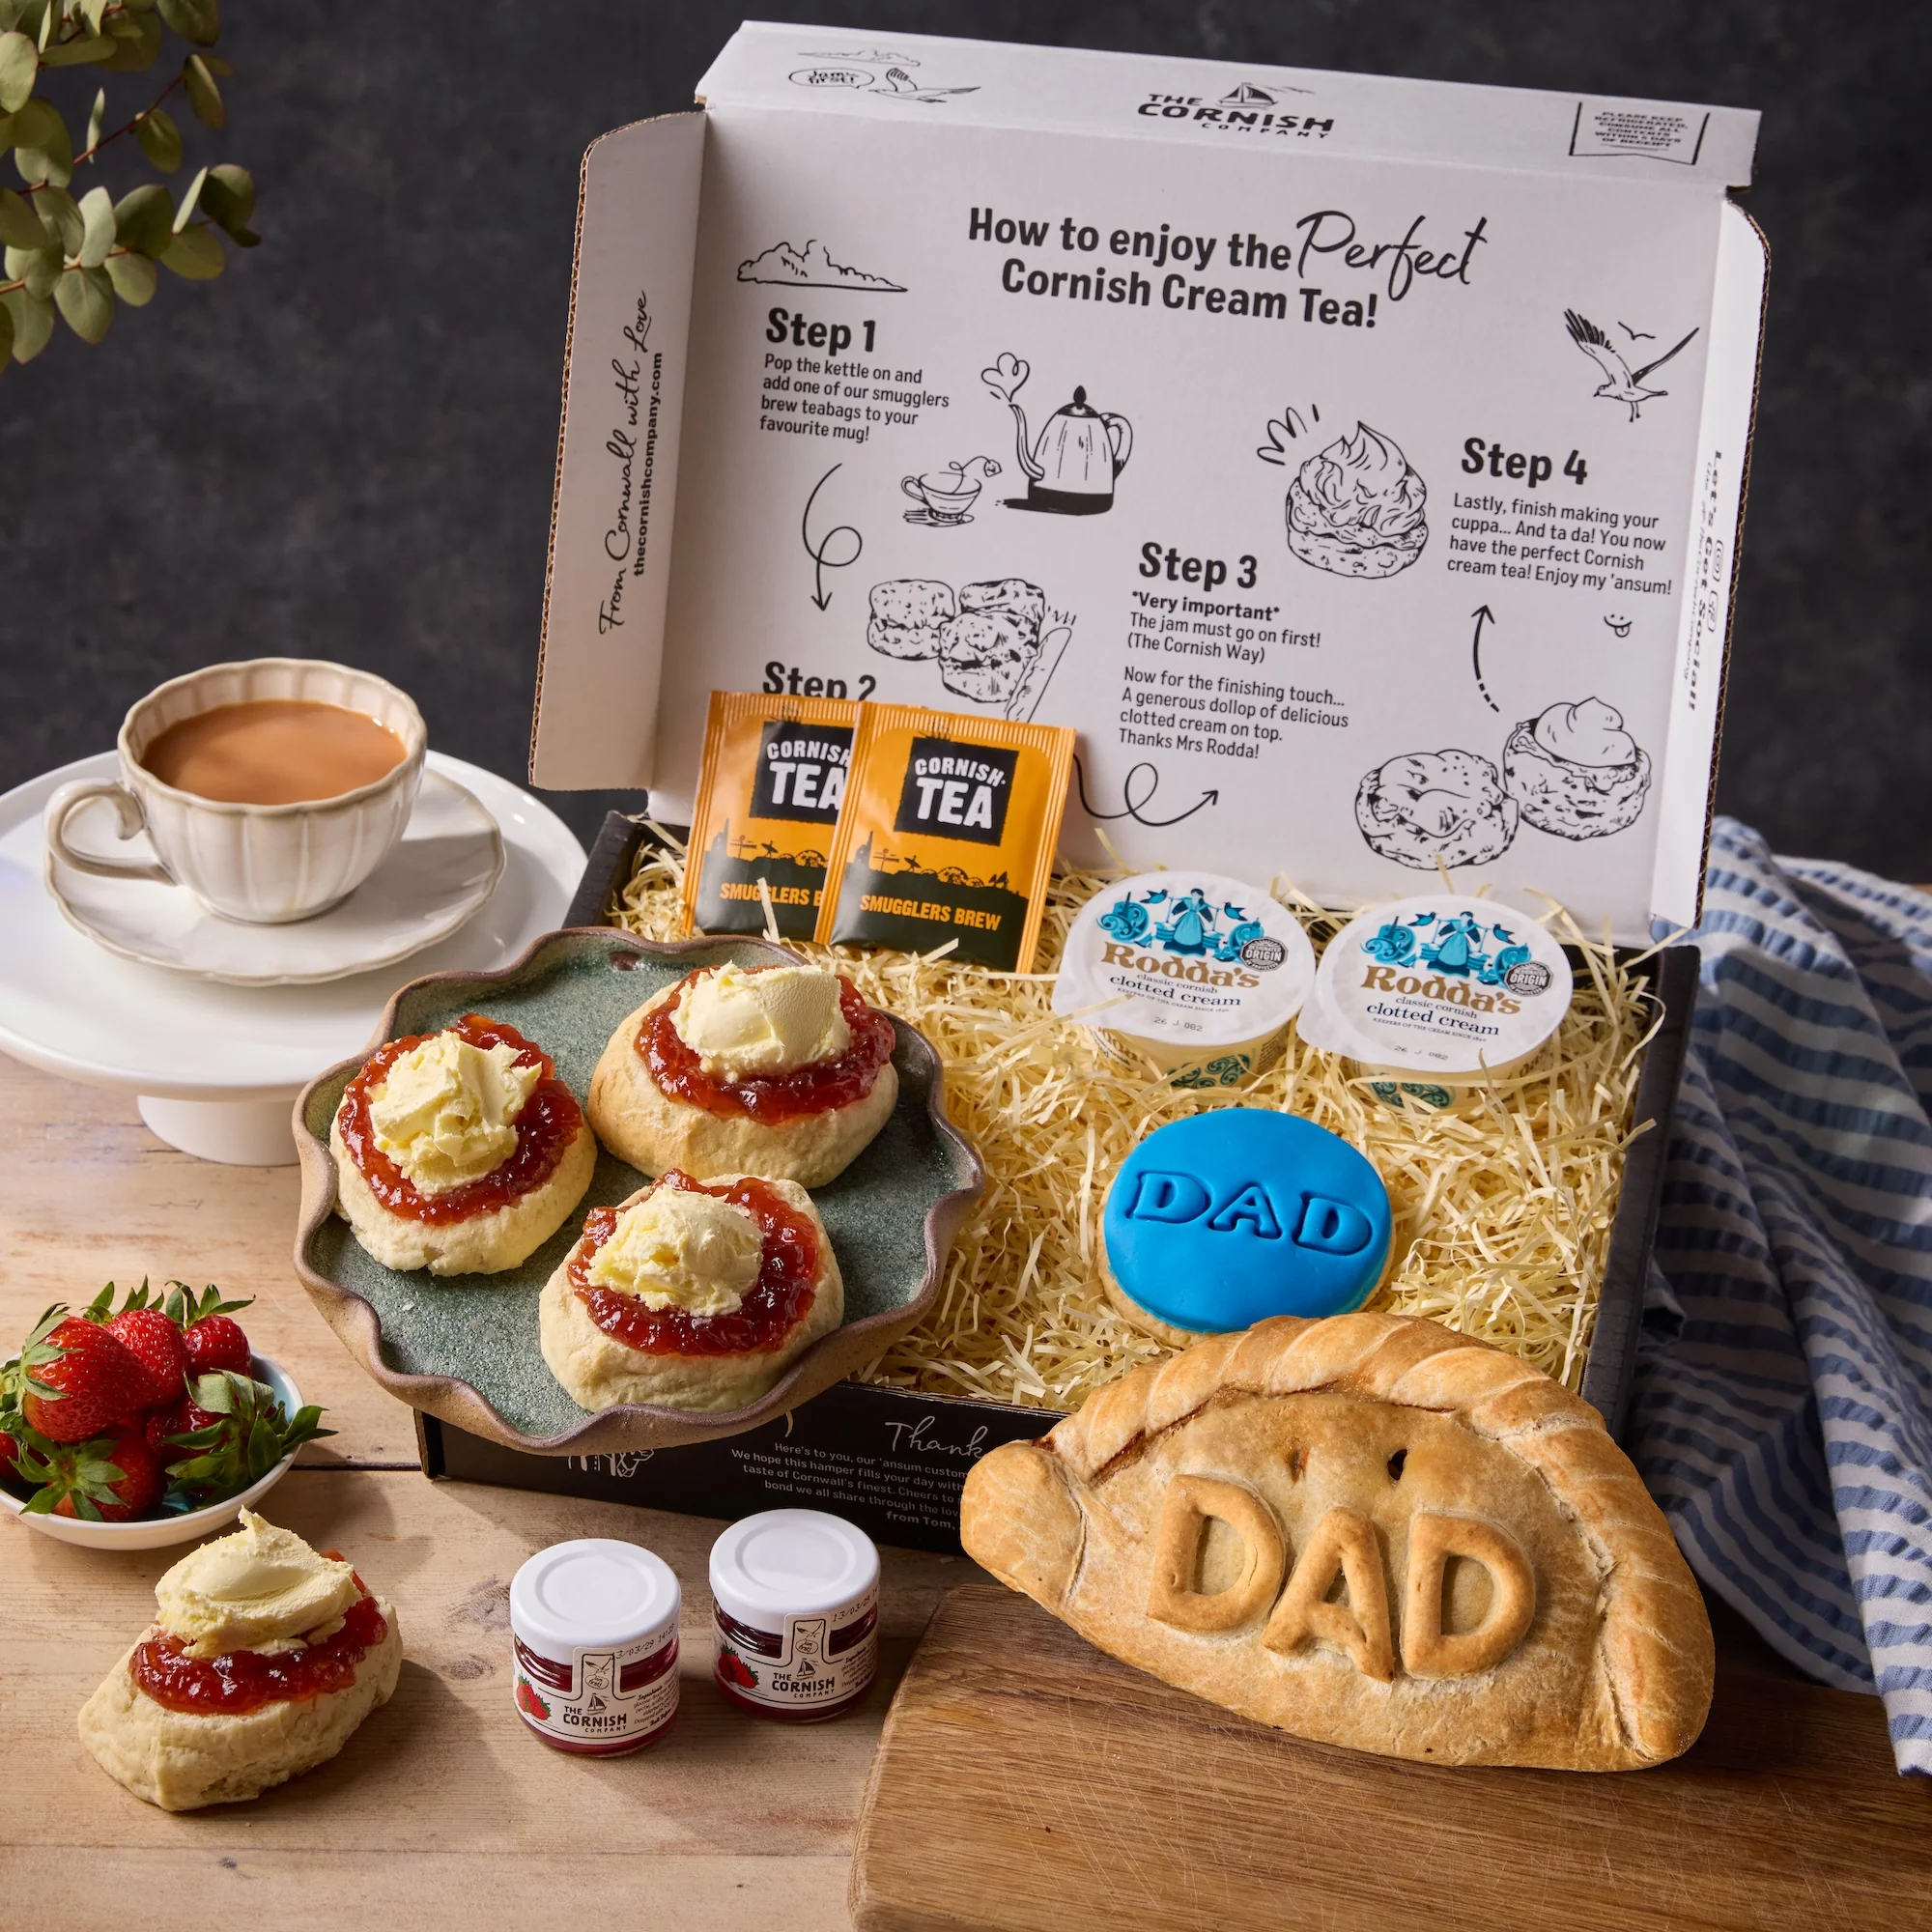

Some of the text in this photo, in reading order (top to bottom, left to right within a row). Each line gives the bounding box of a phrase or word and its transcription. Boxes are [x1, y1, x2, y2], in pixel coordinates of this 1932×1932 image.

[1137, 103, 1335, 132] CORNISH
[1148, 94, 1204, 106] THE
[1201, 123, 1329, 139] COMPANY
[968, 207, 1489, 301] How to enjoy the Perfect
[1001, 258, 1379, 329] Cornish Cream Tea!
[765, 306, 877, 357] Step 1
[764, 353, 923, 384] Pop the kettle on and
[760, 394, 920, 427] brew teabags to your
[762, 375, 951, 409] add one of our smugglers
[759, 414, 870, 445] favourite mug!
[598, 289, 653, 636] From Cornwall with Love
[633, 352, 663, 578] thecornishcompany.com
[1461, 436, 1589, 490] Step 4
[1453, 492, 1661, 530] Lastly, finish making your
[1449, 534, 1645, 572] have the perfect Cornish
[1451, 516, 1667, 553] cuppa... And ta da! You now
[1138, 540, 1259, 593] Step 3
[1446, 558, 1673, 596] cream tea! Enjoy my 'ansum!
[1699, 535, 1714, 591] Get
[1129, 611, 1322, 649] The jam must go on first!
[1126, 631, 1266, 667] (The Cornish Way)
[762, 660, 848, 700] Step
[1123, 666, 1347, 708] Now for the finishing touch...
[1121, 687, 1350, 728] A generous dollop of delicious
[1119, 727, 1261, 760] Thanks Mrs Rodda!
[1120, 709, 1284, 745] clotted cream on top.
[766, 740, 852, 768] CORNISH
[914, 756, 1003, 787] CORNISH
[769, 760, 846, 810] TEA
[915, 777, 993, 830] TEA
[859, 894, 952, 923] SMUGGLERS
[953, 909, 1002, 931] BREW
[1100, 941, 1262, 989] Rodda's
[1245, 949, 1283, 962] ORIGIN
[1109, 976, 1241, 1007] clotted cream
[1136, 973, 1218, 995] classic cornish
[1359, 964, 1522, 1016] Rodda's
[1509, 973, 1548, 987] ORIGIN
[1153, 1016, 1168, 1026] 26
[1184, 1022, 1204, 1033] 082
[1366, 1002, 1500, 1036] clotted cream
[1395, 996, 1478, 1019] classic cornish
[1393, 1045, 1408, 1054] 26
[1126, 1169, 1374, 1257] DAD
[885, 1415, 989, 1460] Thank
[731, 1448, 965, 1492] We hope this hamper fills your day with
[774, 1441, 968, 1480] Here's to you, our 'ansum custom
[743, 1463, 775, 1478] taste
[777, 1466, 790, 1479] of
[792, 1470, 855, 1490] Cornwall's
[857, 1479, 896, 1496] finest.
[897, 1486, 939, 1502] Cheers
[942, 1492, 954, 1505] to
[764, 1479, 960, 1519] bond we all share through the lov
[885, 1511, 956, 1531] from Tom,
[1146, 1473, 1536, 1685] DAD
[772, 1676, 836, 1693] CORNISH
[773, 1672, 793, 1682] THE
[793, 1688, 836, 1699] COMPANY
[562, 1712, 628, 1728] CORNISH
[563, 1705, 583, 1716] THE
[584, 1724, 628, 1734] COMPANY
